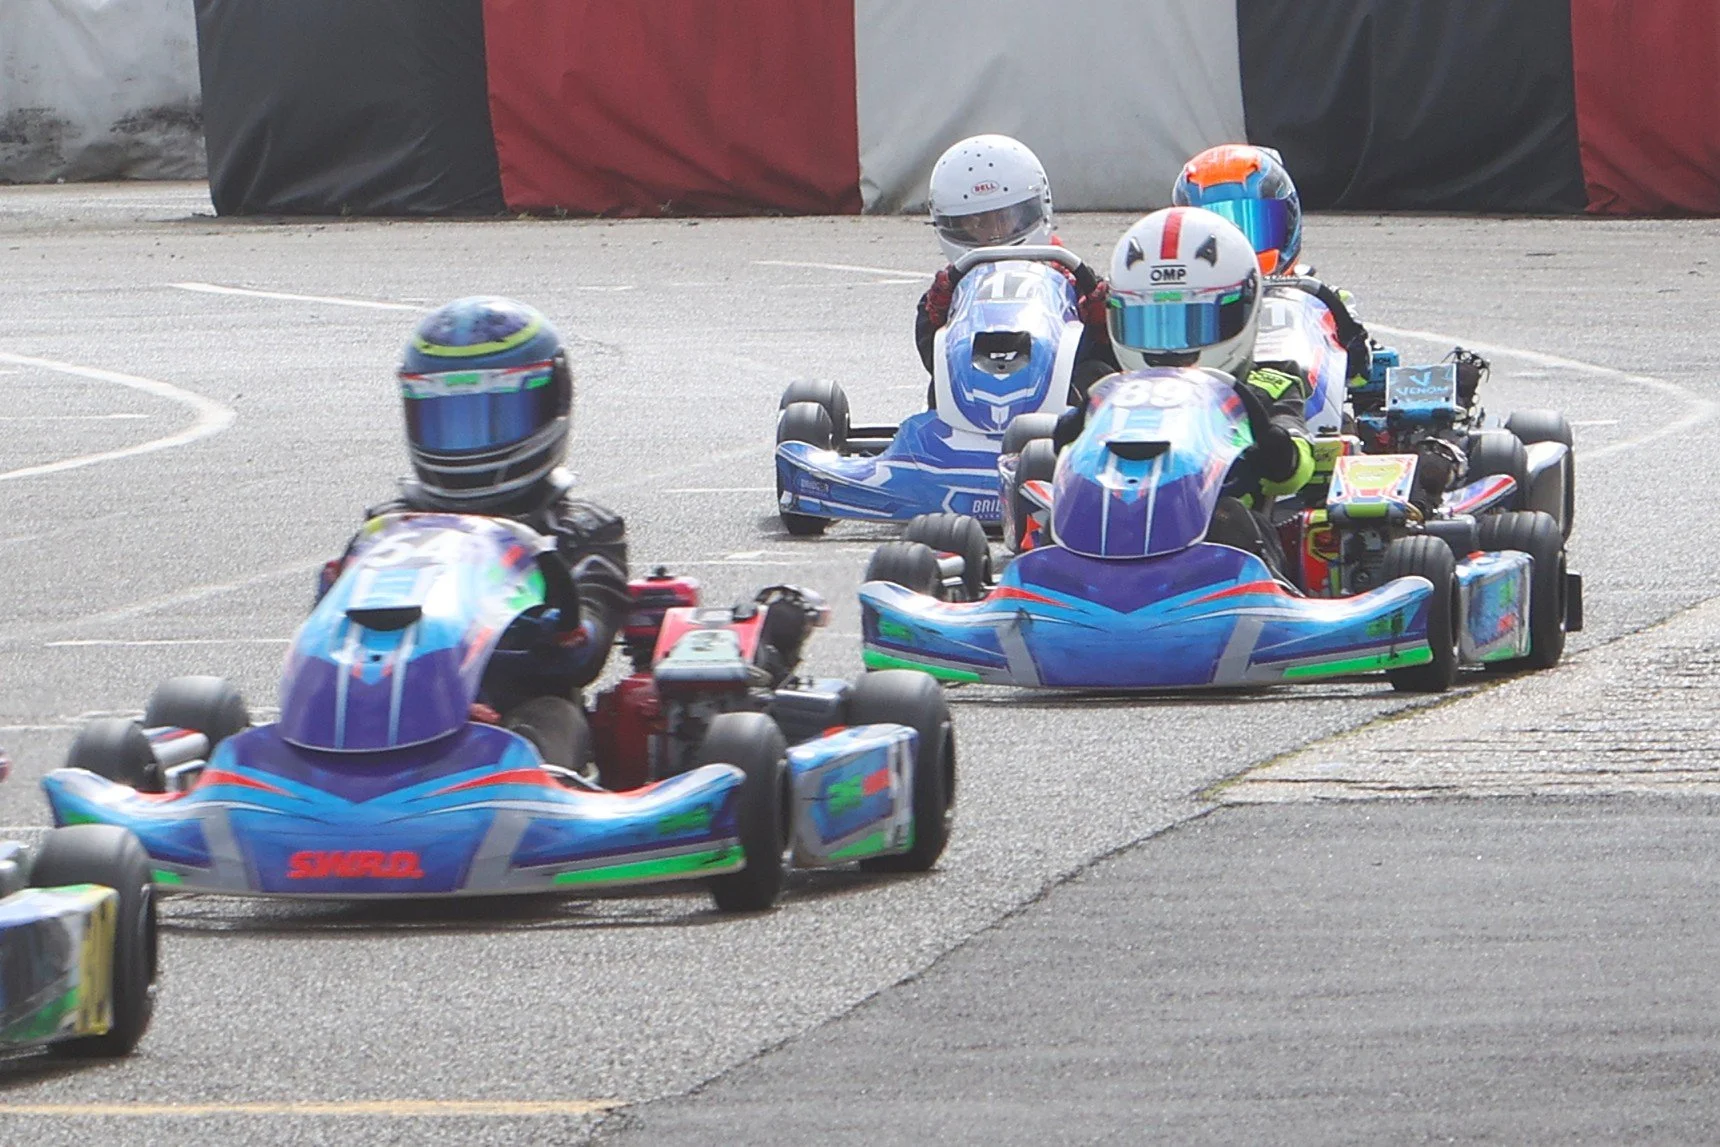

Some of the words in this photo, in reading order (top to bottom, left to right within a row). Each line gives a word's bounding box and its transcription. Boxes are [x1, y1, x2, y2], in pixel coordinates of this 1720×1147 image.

[974, 182, 996, 192] BELL
[1150, 269, 1187, 281] OMP
[983, 271, 1043, 299] 17
[1395, 385, 1449, 396] VENOM
